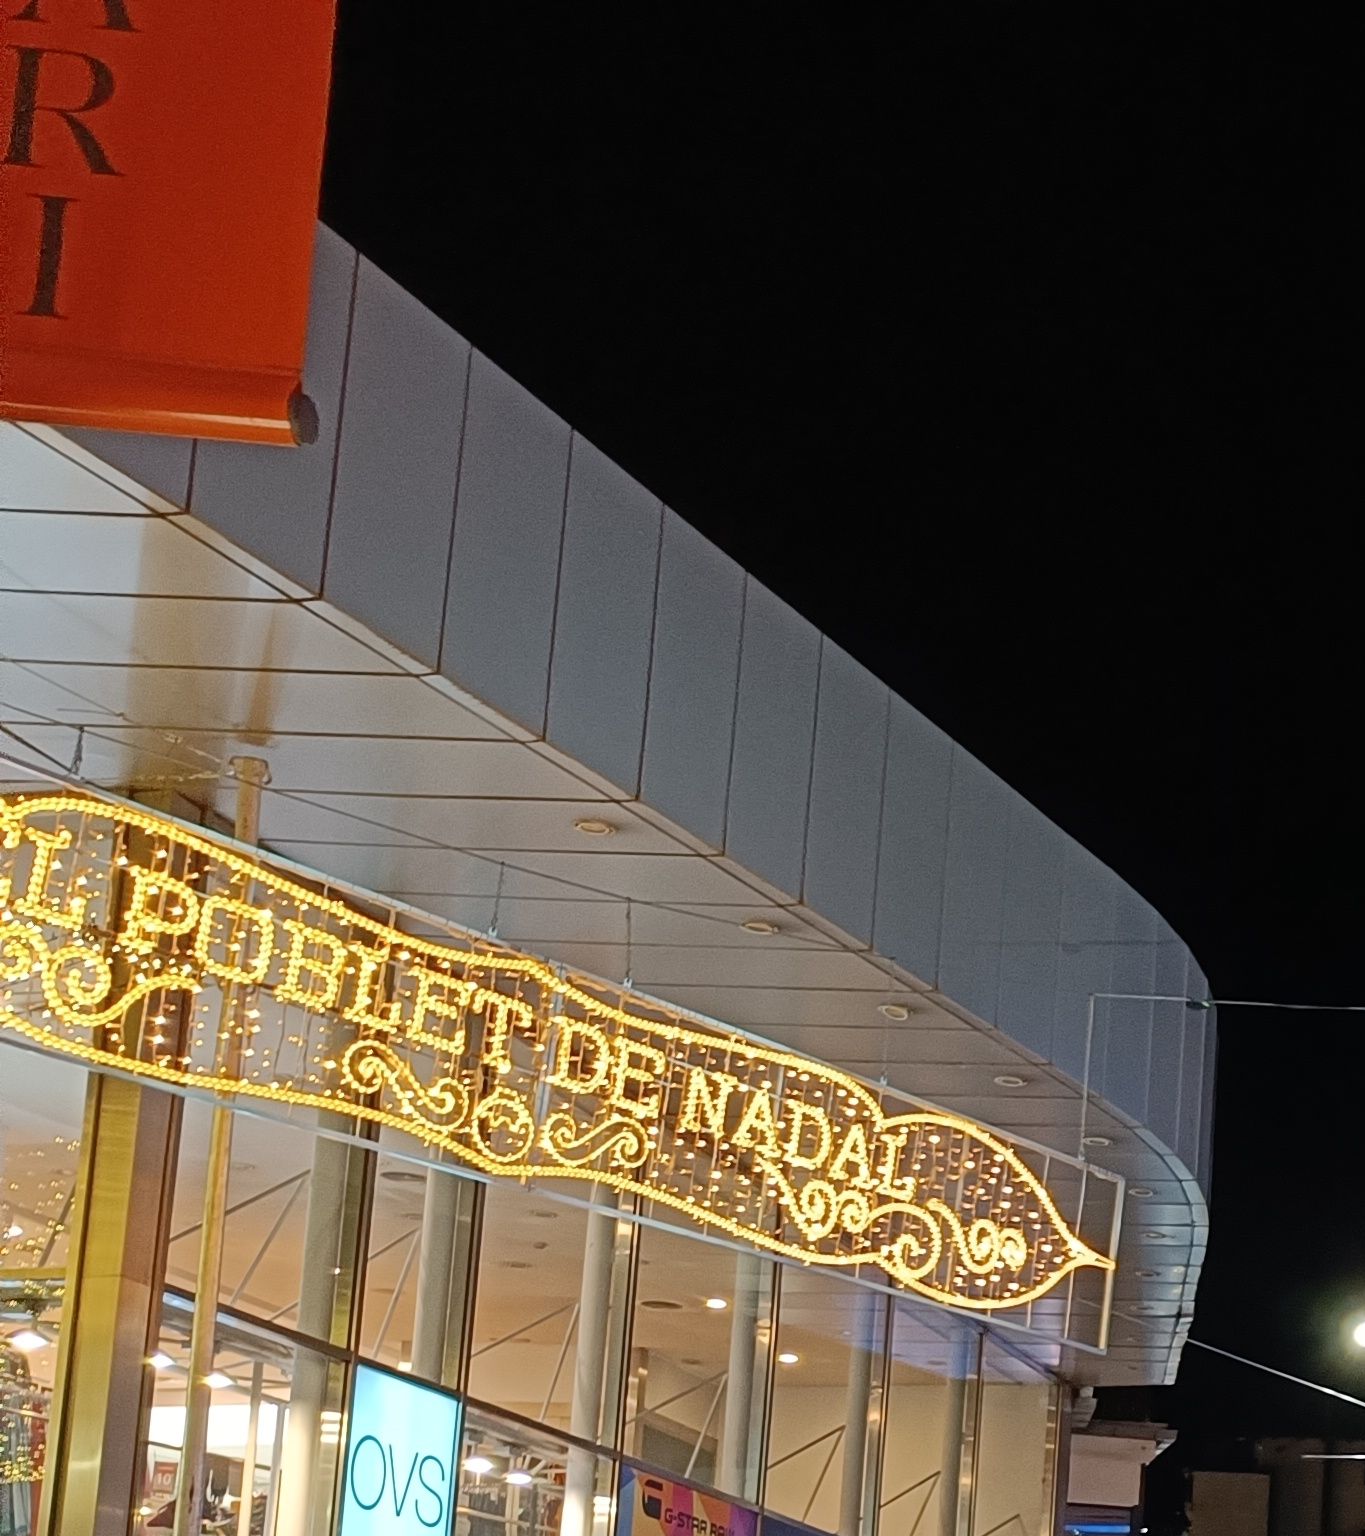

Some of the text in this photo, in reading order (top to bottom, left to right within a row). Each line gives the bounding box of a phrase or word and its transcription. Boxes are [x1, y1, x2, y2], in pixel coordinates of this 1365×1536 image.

[119, 866, 534, 1074] POBLET
[550, 1016, 666, 1118] DE
[679, 1065, 917, 1204] NADAL
[350, 1434, 445, 1528] OVS
